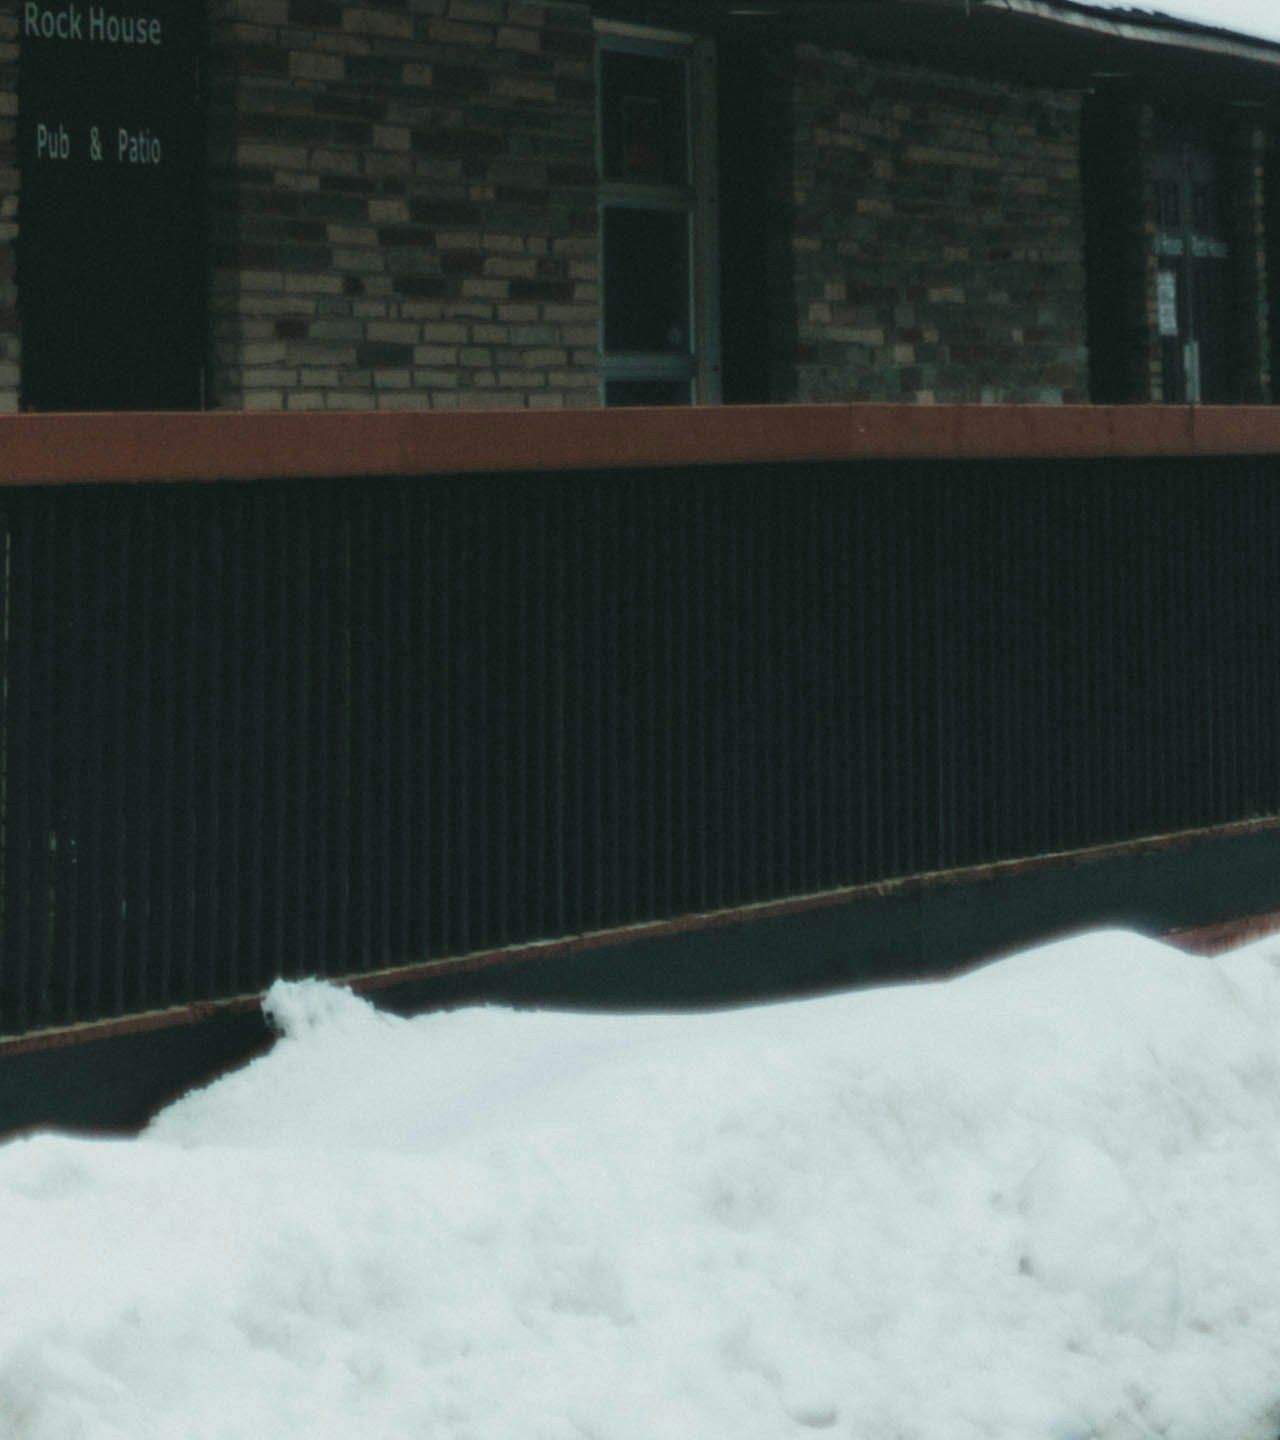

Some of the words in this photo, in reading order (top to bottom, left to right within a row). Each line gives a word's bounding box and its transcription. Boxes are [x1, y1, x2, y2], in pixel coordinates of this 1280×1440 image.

[24, 2, 82, 39] Rock
[89, 8, 161, 45] House
[37, 124, 69, 160] Pub
[91, 127, 103, 161] &
[119, 129, 161, 164] Patio
